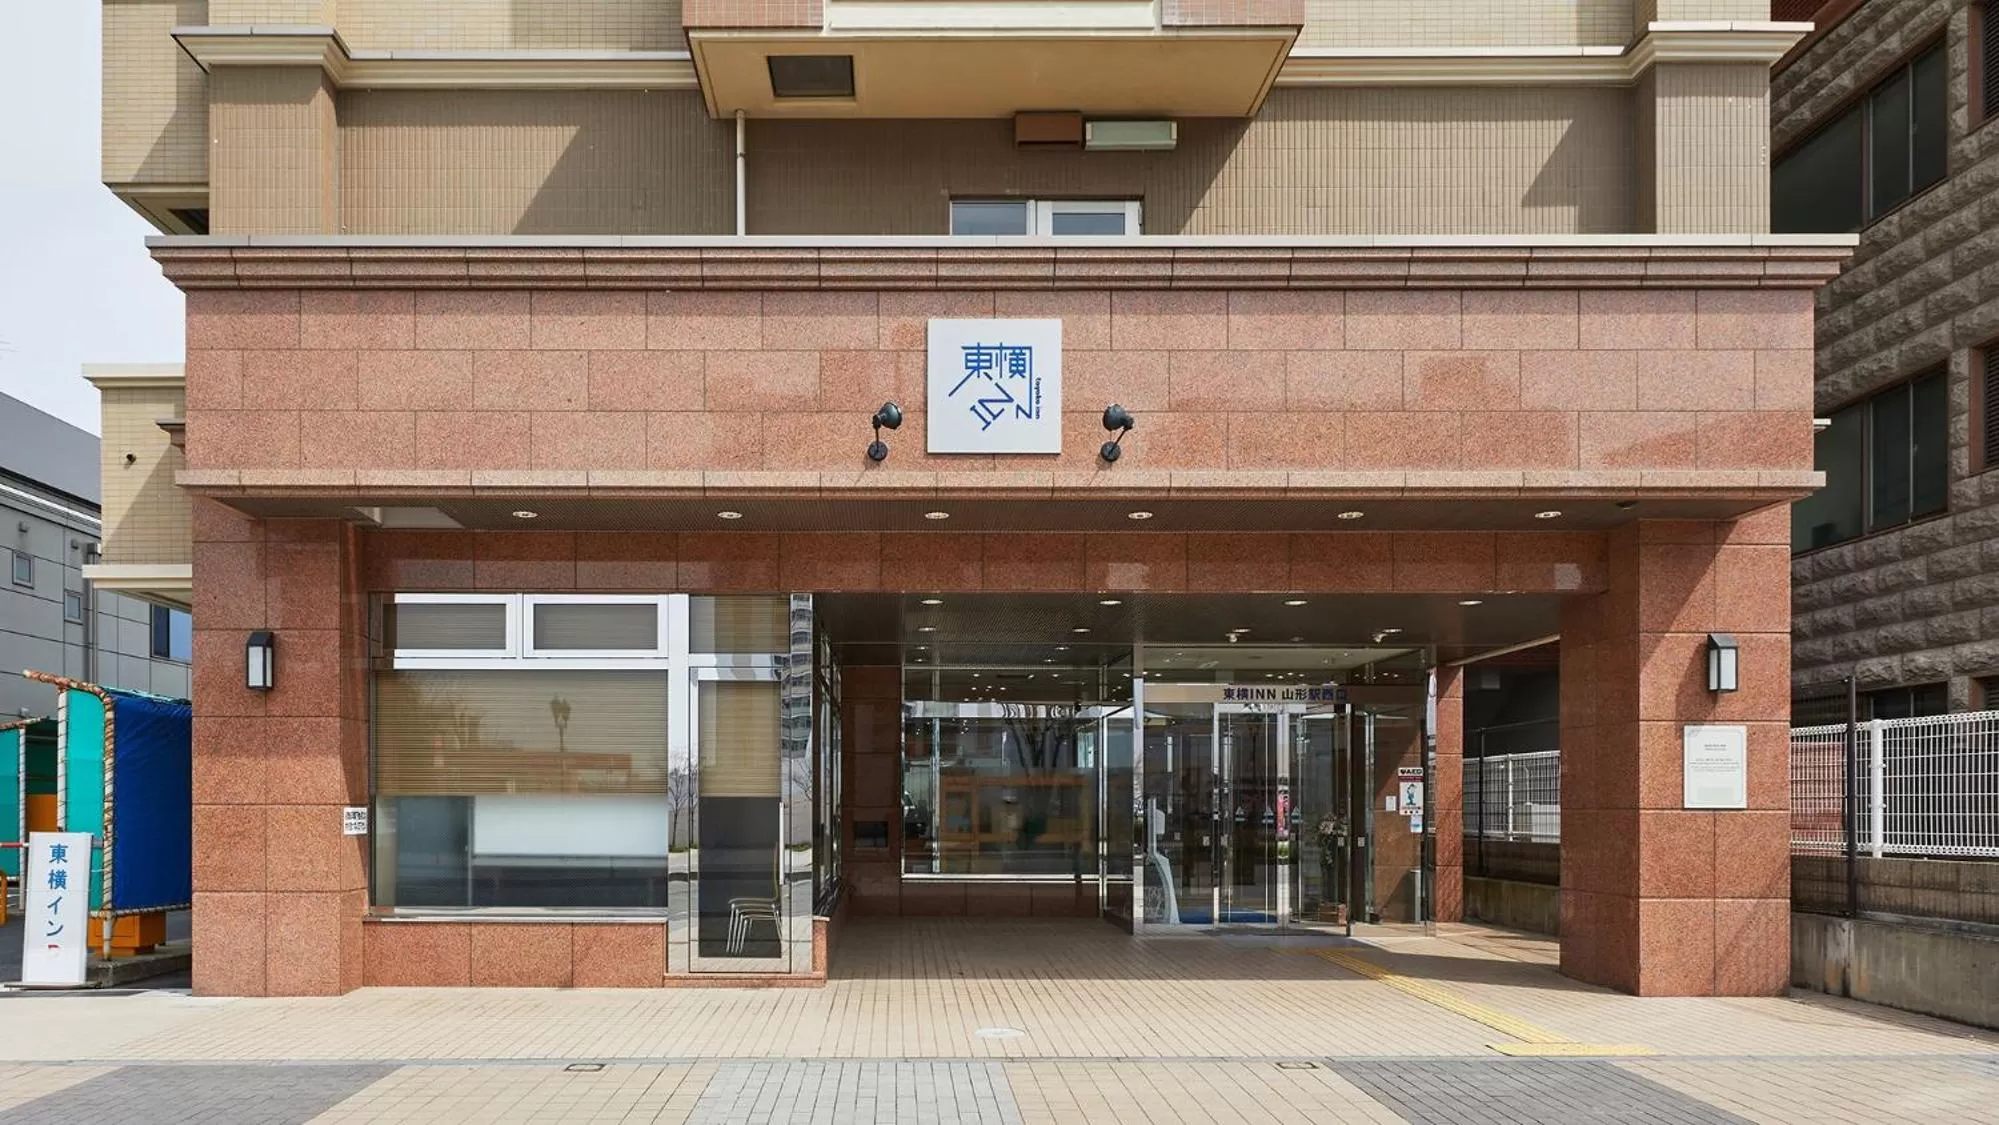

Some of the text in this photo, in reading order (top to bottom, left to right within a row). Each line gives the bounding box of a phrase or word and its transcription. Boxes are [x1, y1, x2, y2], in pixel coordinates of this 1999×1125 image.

[1223, 688, 1276, 700] 東横INN
[46, 843, 69, 936] 東横イン
